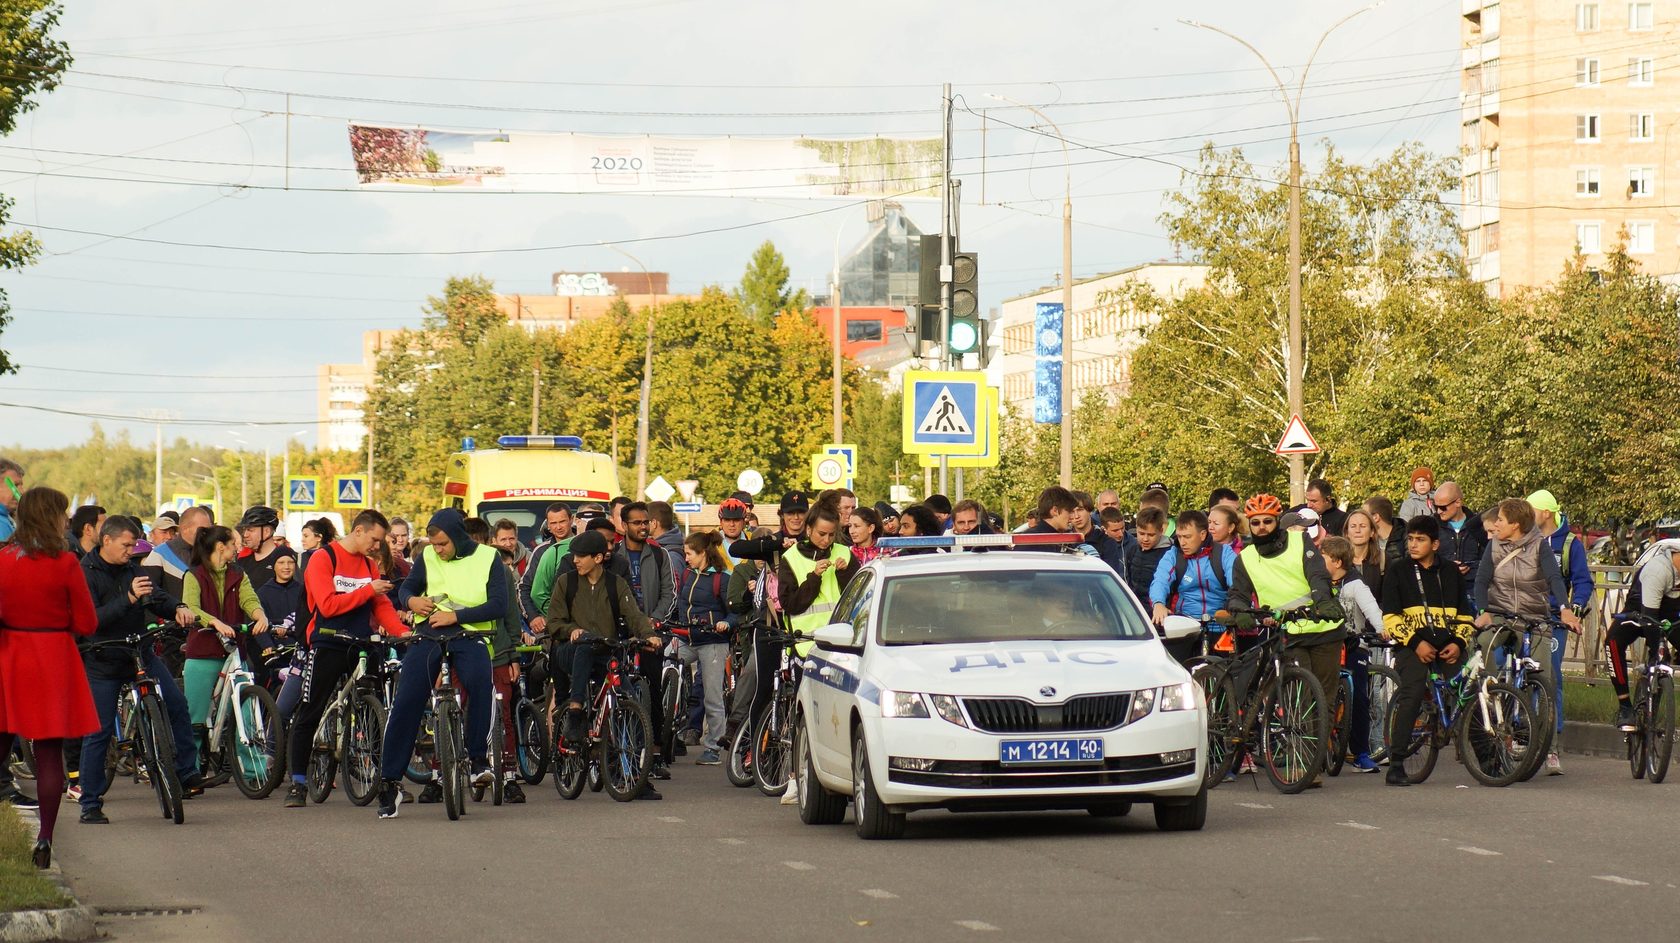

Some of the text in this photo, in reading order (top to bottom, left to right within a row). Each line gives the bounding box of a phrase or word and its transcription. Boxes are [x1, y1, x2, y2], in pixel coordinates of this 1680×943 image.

[591, 156, 643, 171] 2020
[822, 466, 837, 477] 30
[505, 488, 588, 497] РЕАНИМАЦИЯ
[949, 650, 1119, 673] ДПС
[1027, 741, 1070, 759] 1214
[1080, 740, 1097, 753] 40
